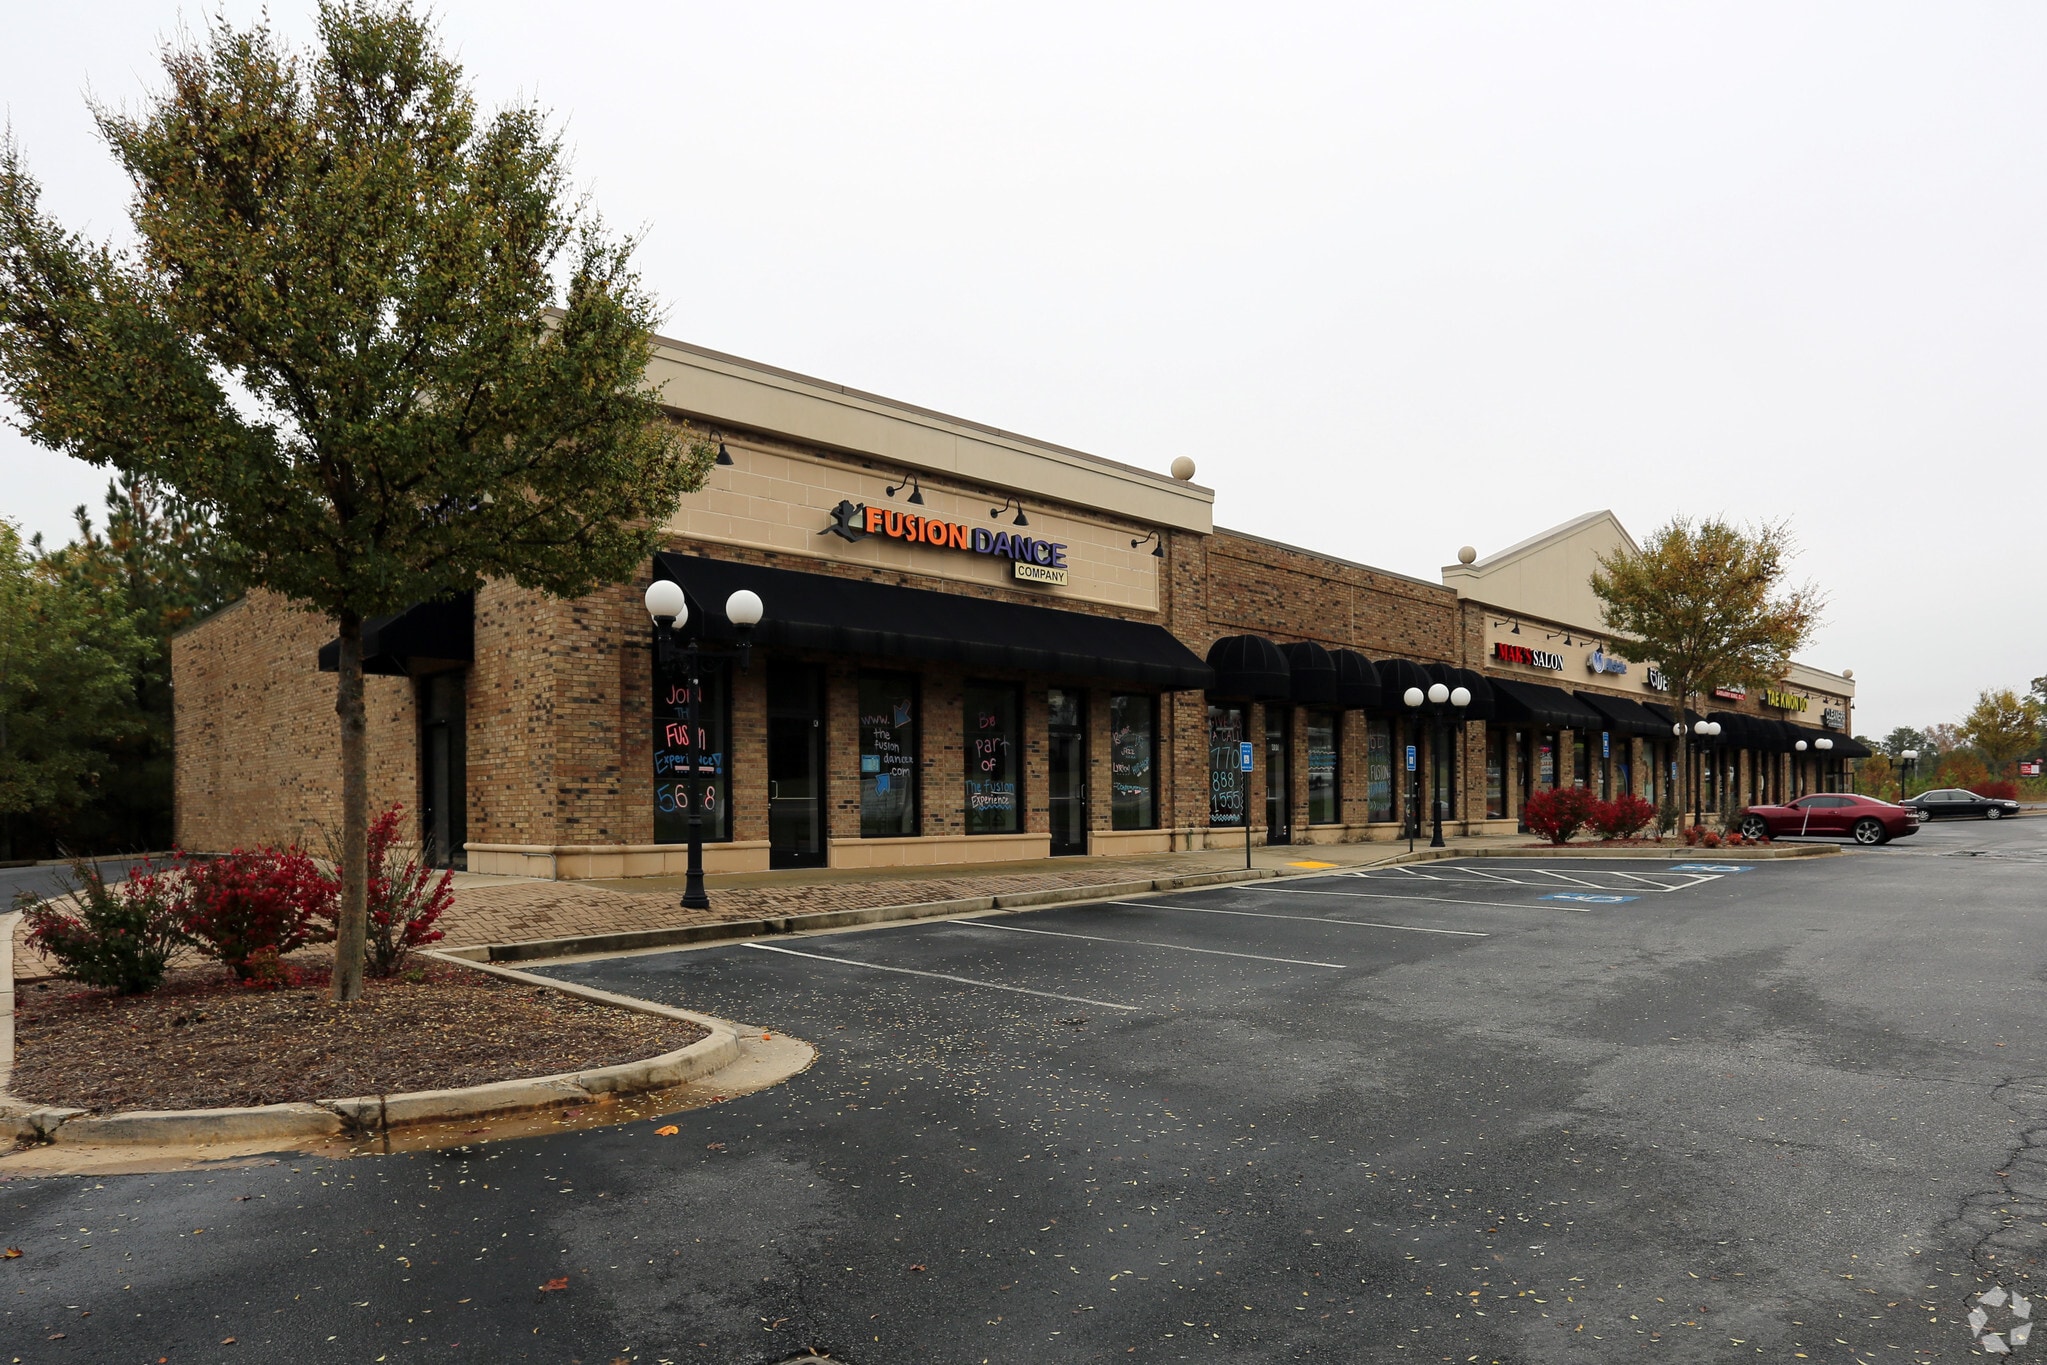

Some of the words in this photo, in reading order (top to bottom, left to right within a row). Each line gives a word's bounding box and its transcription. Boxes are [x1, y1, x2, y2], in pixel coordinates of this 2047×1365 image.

[865, 506, 968, 550] FUSION
[975, 527, 1068, 569] DANCE
[1017, 565, 1065, 582] COMPANY
[1533, 649, 1564, 672] SALON
[1767, 688, 1780, 707] TAE
[1780, 692, 1799, 711] KWON
[1800, 697, 1808, 712] DO
[873, 727, 891, 741] the
[1221, 730, 1241, 743] CALL
[975, 735, 1011, 758] part
[1210, 746, 1241, 769] 770
[1212, 771, 1235, 792] 888
[1370, 764, 1389, 781] FUSION
